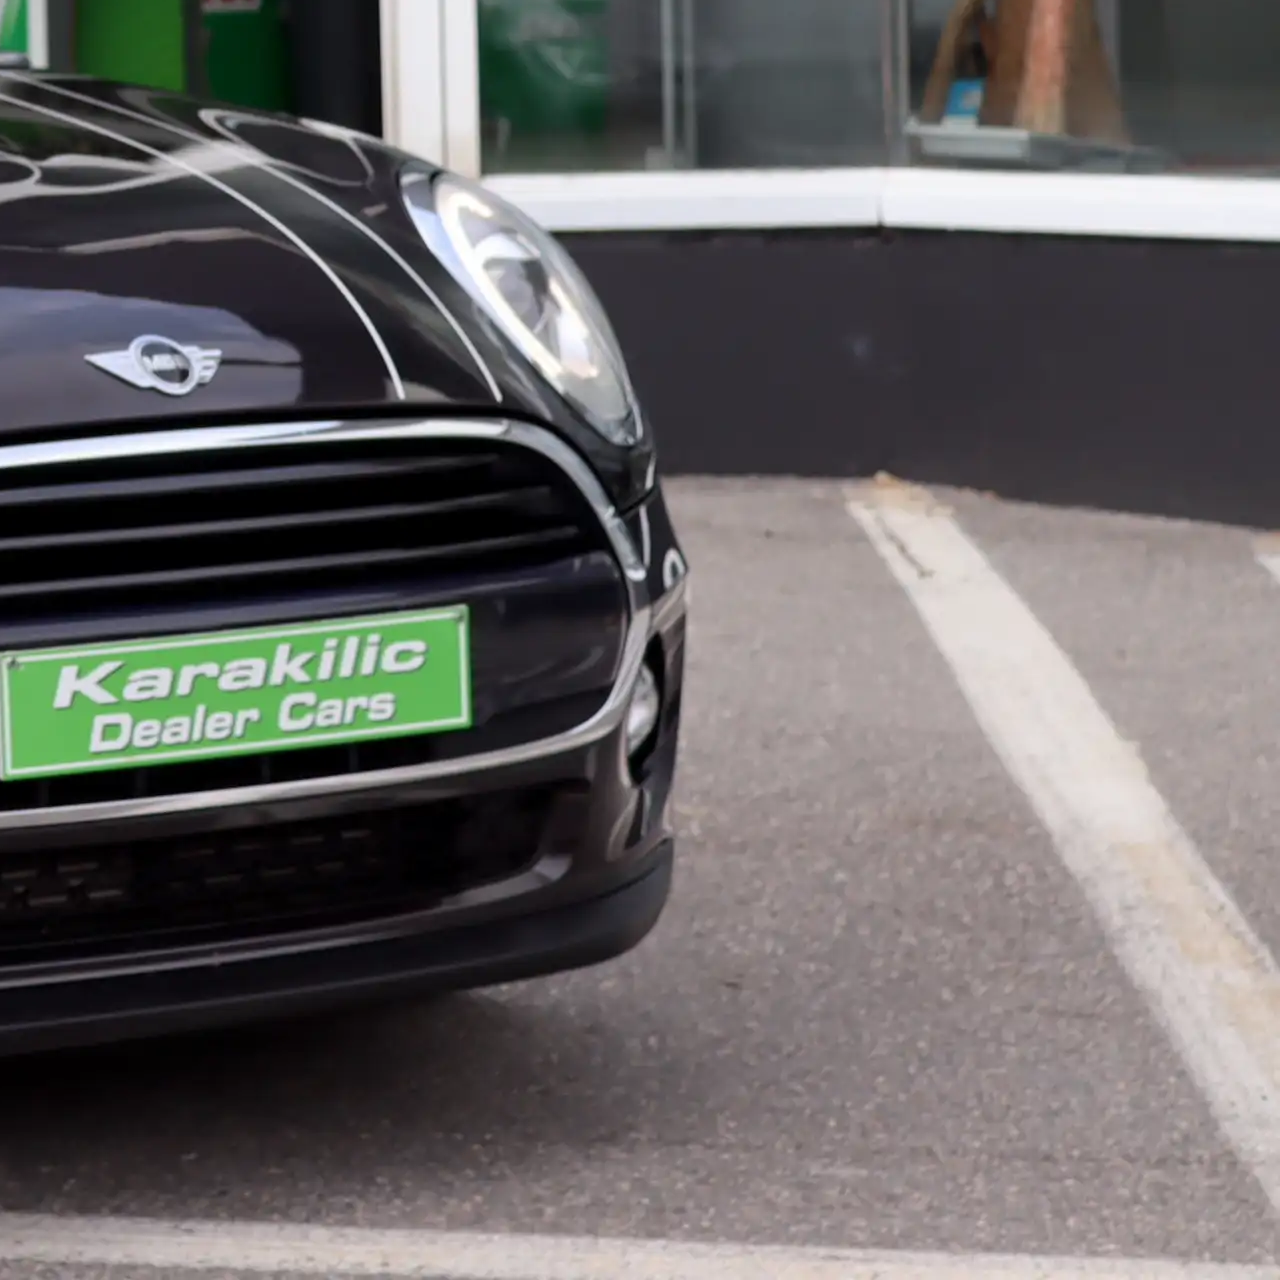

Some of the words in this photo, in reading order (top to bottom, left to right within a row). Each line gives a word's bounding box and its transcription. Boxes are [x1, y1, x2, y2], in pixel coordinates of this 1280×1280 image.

[52, 633, 428, 709] Karakilic
[89, 703, 261, 754] Dealer
[277, 691, 397, 732] Cars
